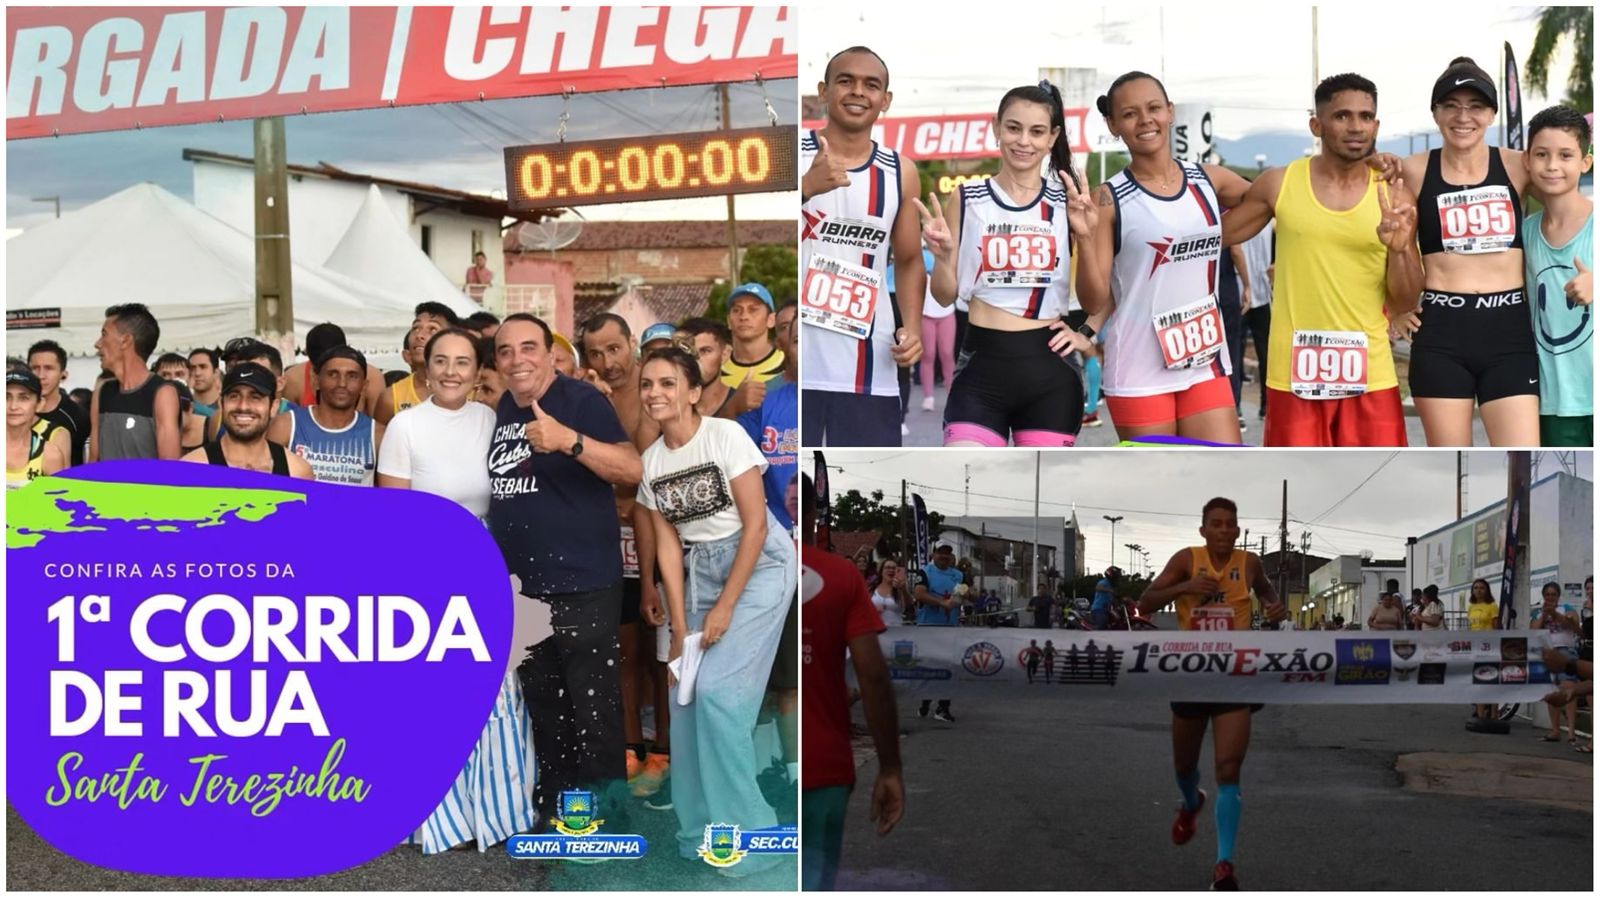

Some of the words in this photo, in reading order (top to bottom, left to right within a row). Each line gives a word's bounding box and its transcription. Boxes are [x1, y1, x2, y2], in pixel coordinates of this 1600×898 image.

[521, 138, 769, 198] 0:0:00:00
[1446, 203, 1511, 236] 095
[820, 222, 887, 243] IBIARA
[822, 236, 878, 249] RUNNERS
[988, 236, 1051, 269] 033
[807, 273, 872, 319] 053
[1424, 292, 1466, 308] PRO
[1475, 292, 1523, 309] NIKE
[1165, 313, 1218, 360] 088
[1298, 348, 1363, 382] 090
[494, 422, 527, 443] CHICA
[306, 452, 362, 466] MARATONA
[1162, 641, 1200, 651] CORRIDA
[1201, 642, 1214, 651] DE
[1215, 642, 1233, 651] RUA
[1158, 648, 1334, 676] CONEXÃO
[1280, 672, 1328, 683] FM
